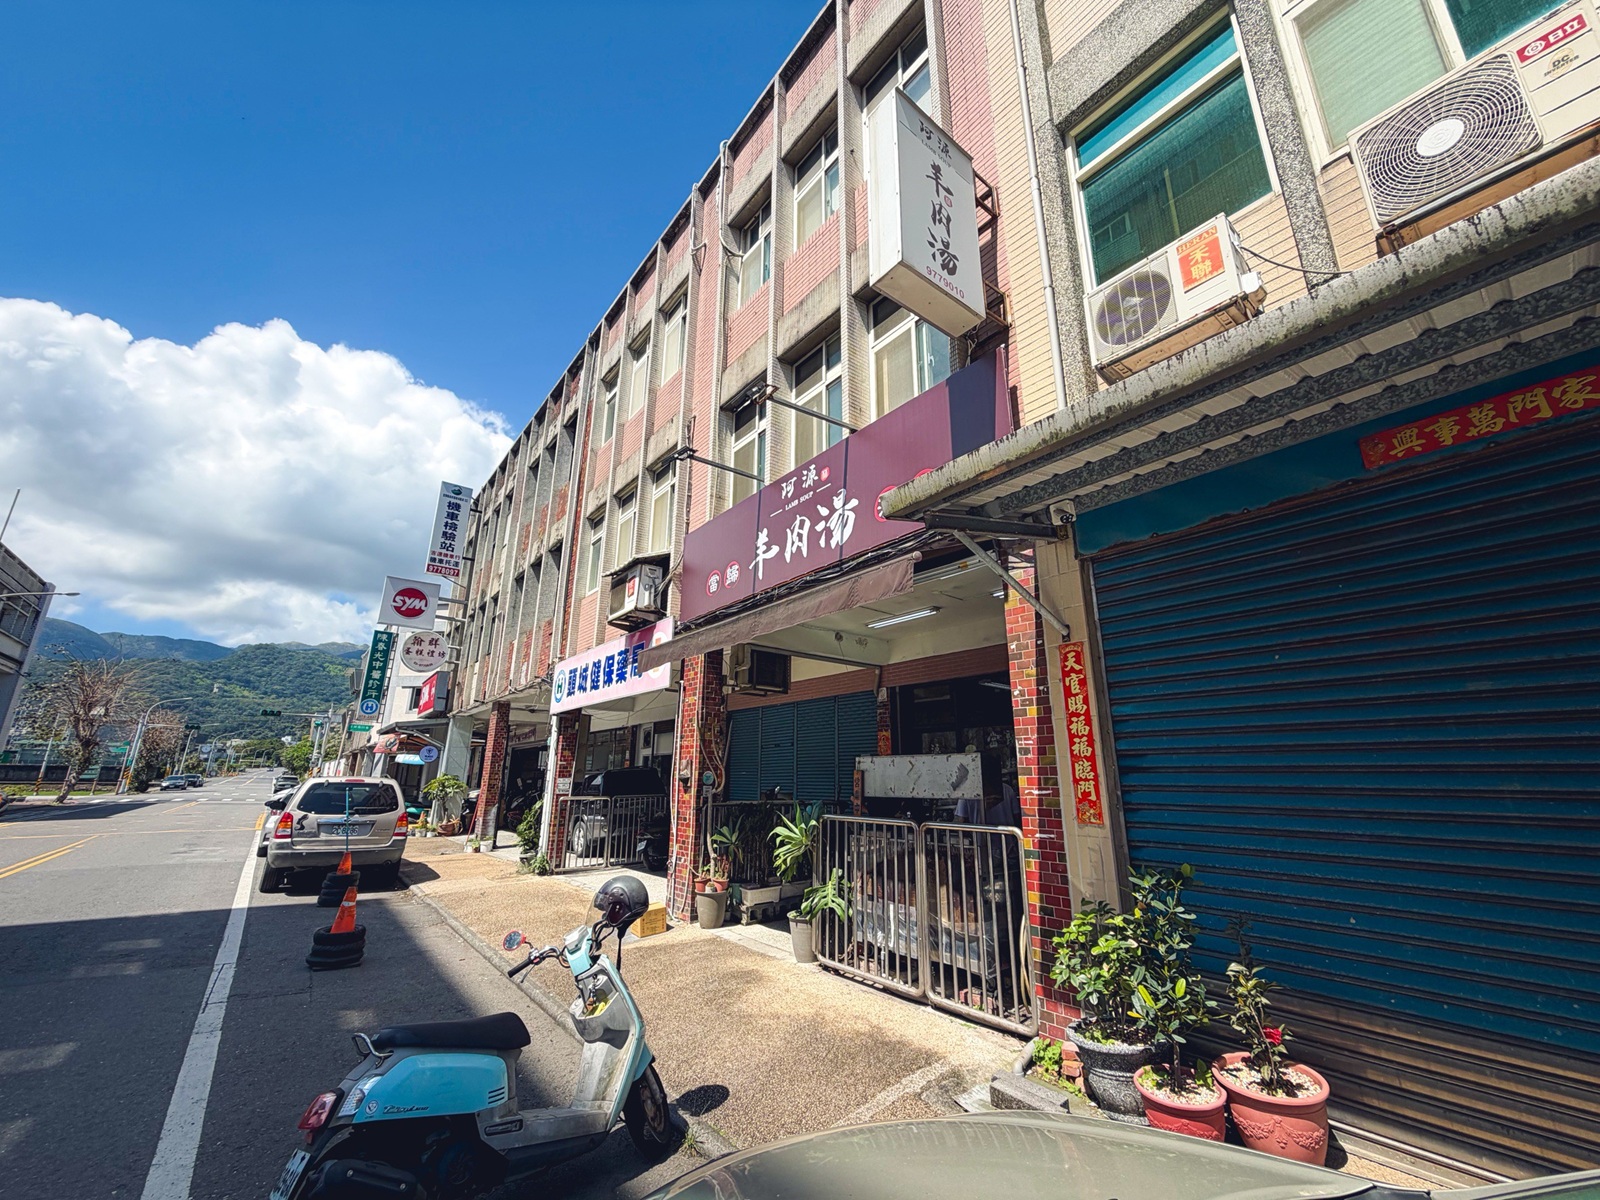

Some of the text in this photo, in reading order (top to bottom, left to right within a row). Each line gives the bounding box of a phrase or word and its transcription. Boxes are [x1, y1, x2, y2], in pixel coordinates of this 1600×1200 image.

[1547, 19, 1583, 43] 日立
[1543, 55, 1580, 77] INVERTER
[1552, 54, 1571, 67] DC
[918, 118, 952, 160] 阿源
[925, 159, 960, 277] 羊肉湯
[1176, 226, 1218, 254] HERAN
[1189, 244, 1213, 280] 禾聯
[926, 265, 965, 299] 9779010
[781, 463, 818, 500] 阿源
[785, 491, 814, 511] LAMB SOUP
[439, 500, 462, 553] 機車檢驗站
[748, 488, 859, 580] 羊肉湯
[428, 565, 459, 576] 9778097
[708, 564, 739, 593] 當歸
[391, 595, 428, 611] SYM
[366, 633, 388, 698] 陳春光中醫診所
[1064, 652, 1097, 801] 天官賜福福臨門
